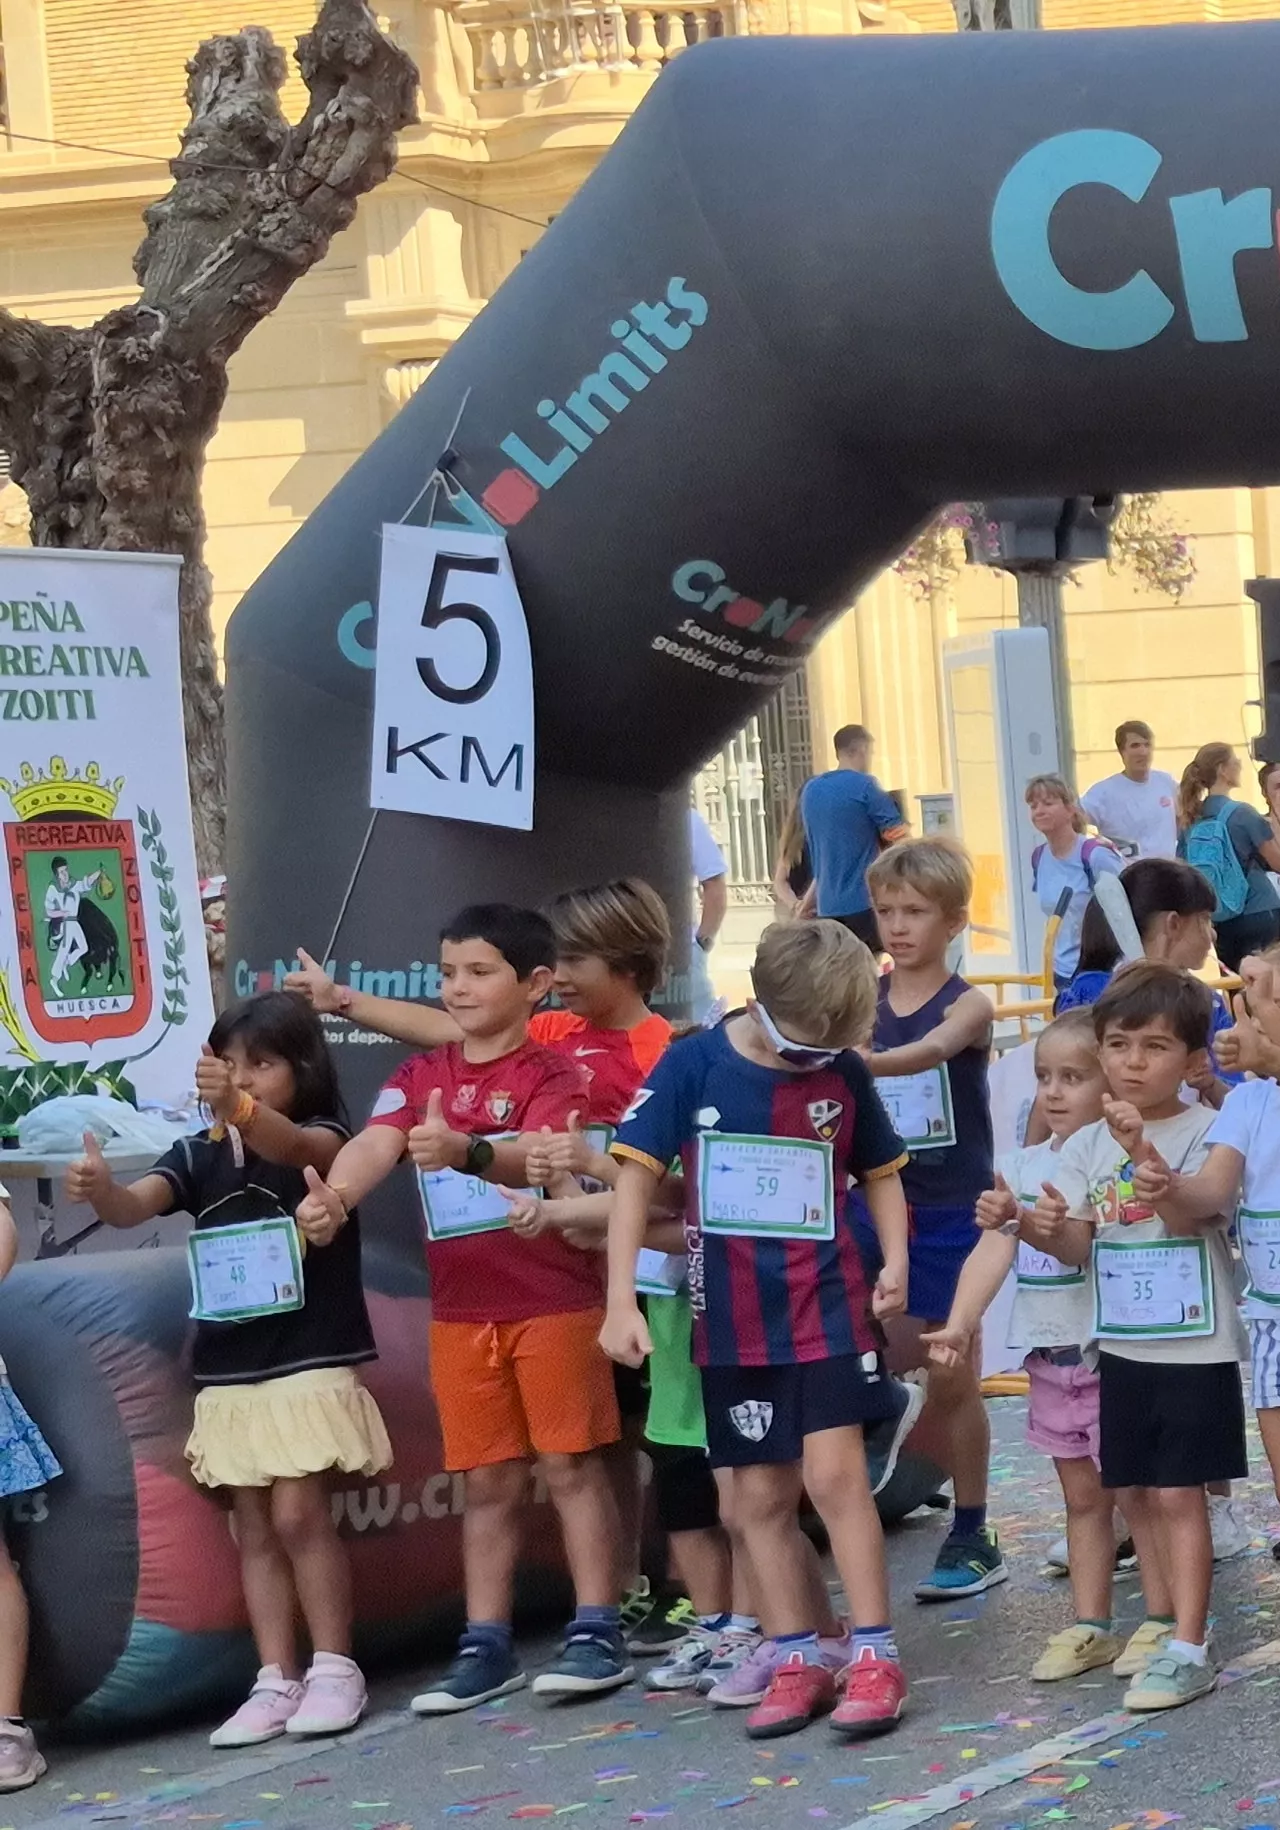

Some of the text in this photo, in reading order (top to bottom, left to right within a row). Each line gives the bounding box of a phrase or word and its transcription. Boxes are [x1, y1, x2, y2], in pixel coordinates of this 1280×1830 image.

[415, 549, 501, 705] 5
[0, 688, 97, 722] ZOITI
[385, 726, 525, 792] KM
[16, 823, 127, 846] RECREATIVA
[57, 997, 121, 1014] HUESCA
[755, 1175, 779, 1197] 59
[230, 1264, 247, 1285] 48
[1133, 1279, 1154, 1301] 35
